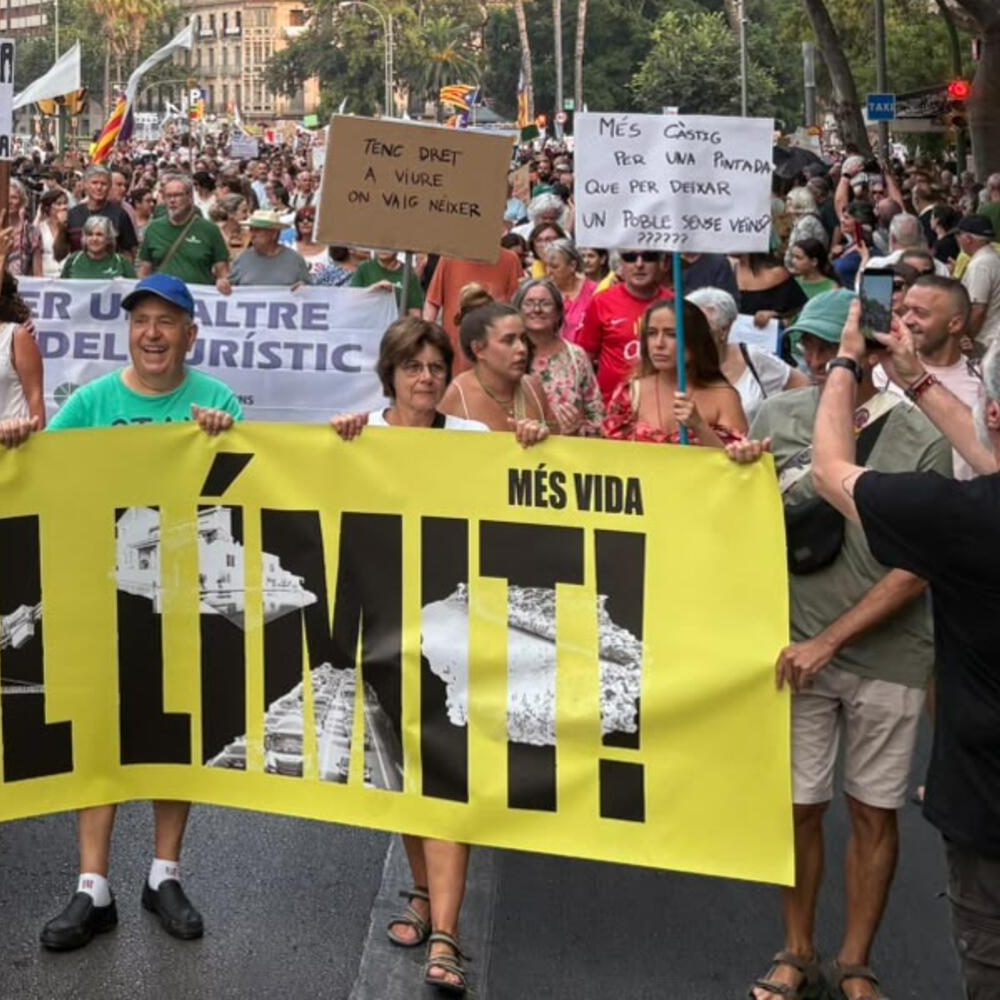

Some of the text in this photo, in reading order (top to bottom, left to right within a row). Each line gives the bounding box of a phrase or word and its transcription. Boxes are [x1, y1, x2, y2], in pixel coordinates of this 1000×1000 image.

[869, 103, 893, 112] TAXI
[599, 116, 722, 144] MÉS CÀSTIG
[364, 138, 463, 166] TENC DRET
[614, 150, 646, 166] PER
[665, 152, 696, 166] UNA
[364, 167, 376, 183] A
[585, 179, 731, 196] QUE PER DEIXAR
[348, 190, 370, 204] ON
[382, 193, 419, 210] VAIG
[583, 211, 606, 229] UN
[623, 210, 671, 230] POBLE
[681, 214, 722, 231] SENSE
[18, 291, 72, 320] ER
[90, 293, 129, 321] U
[38, 331, 362, 373] DEL URÍSTIC
[508, 463, 643, 515] MÉS VIDA
[115, 452, 646, 822] LÍMIT!
